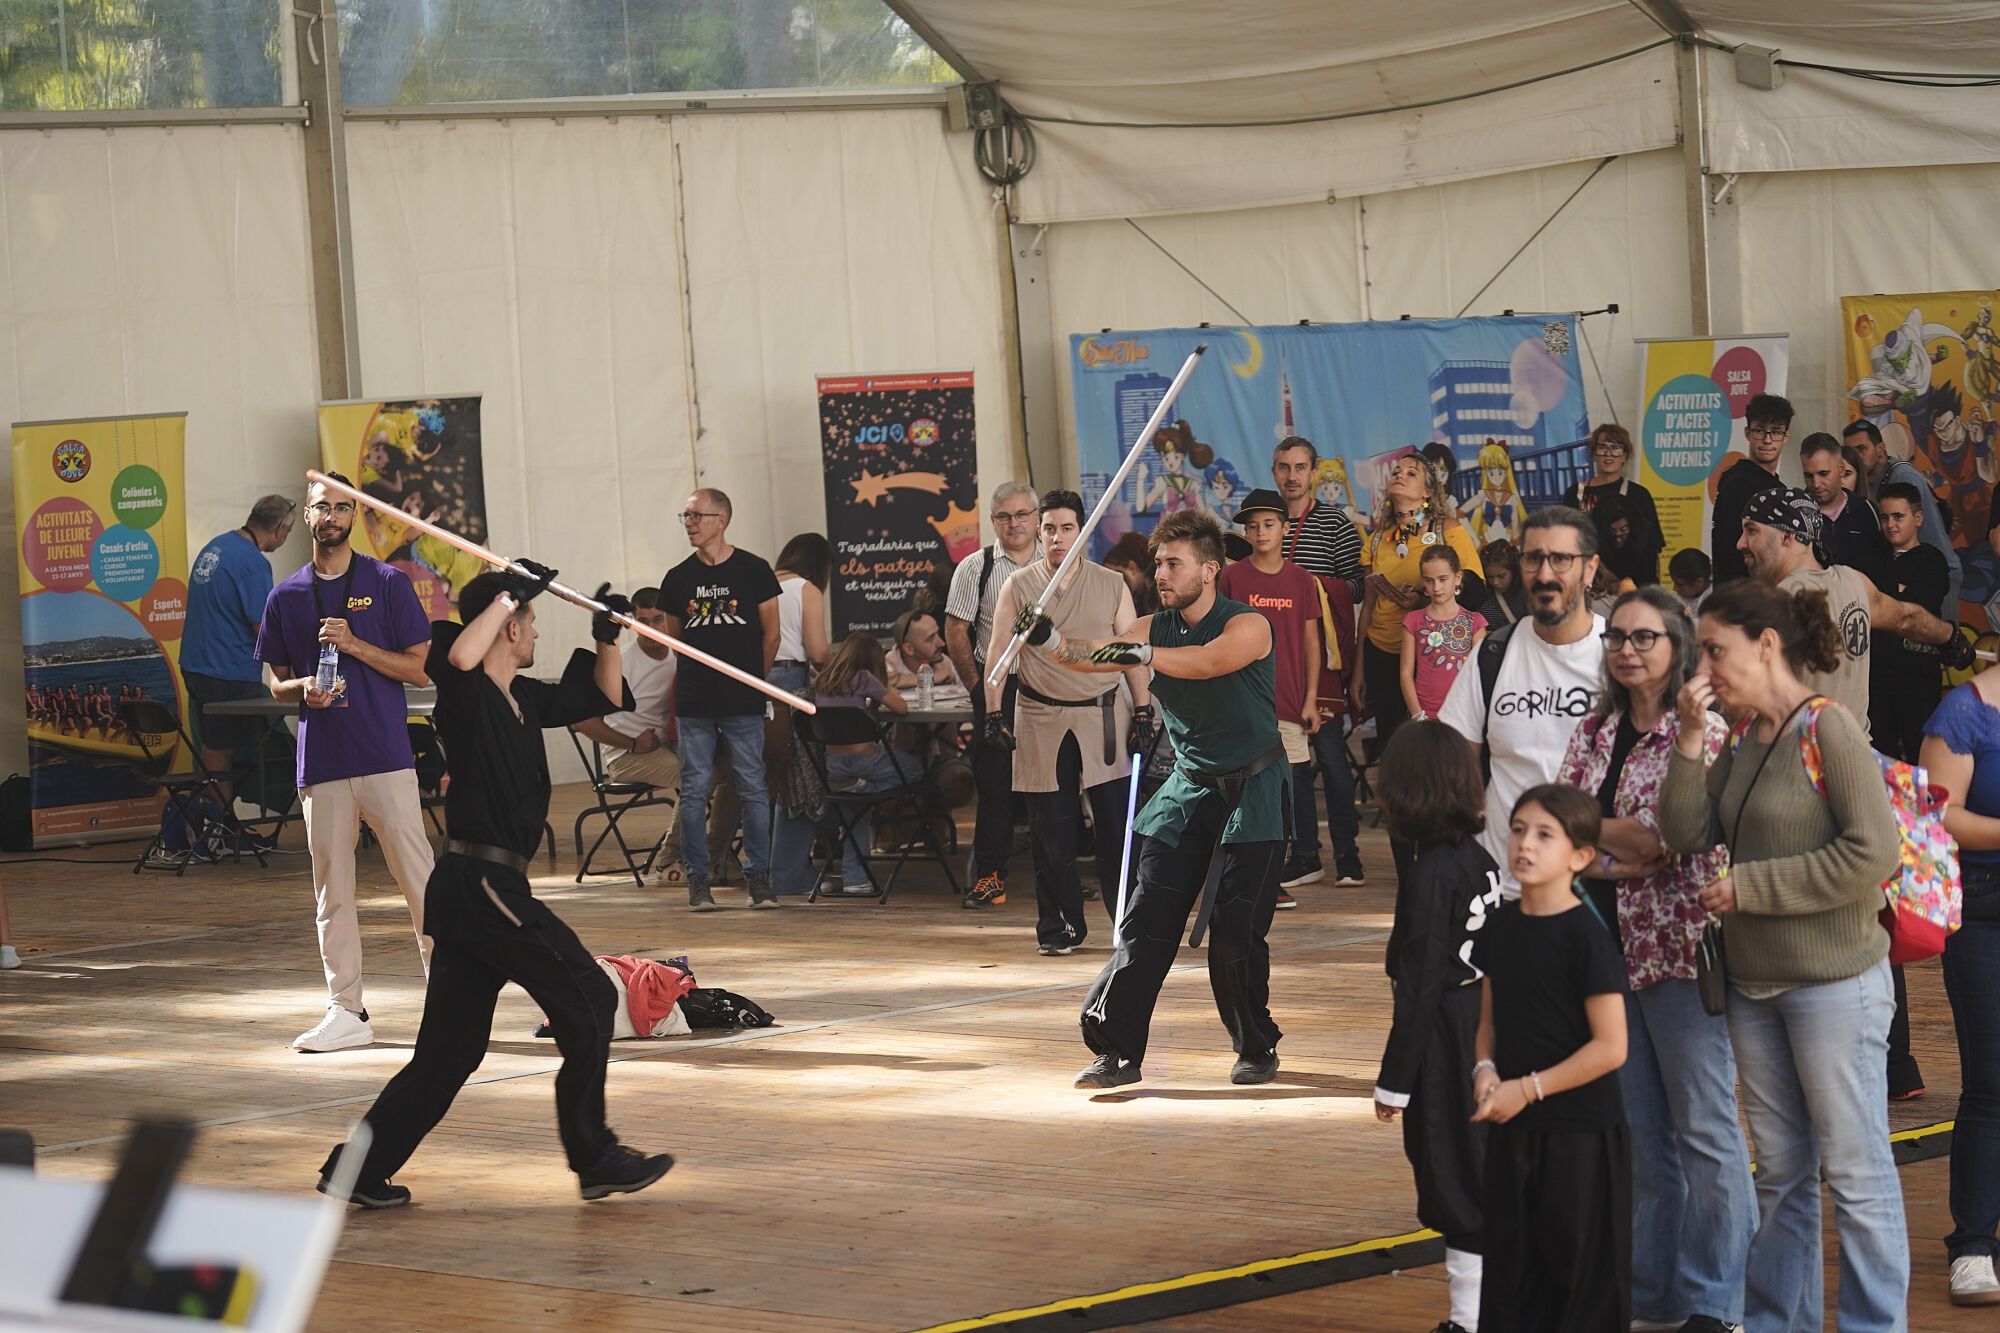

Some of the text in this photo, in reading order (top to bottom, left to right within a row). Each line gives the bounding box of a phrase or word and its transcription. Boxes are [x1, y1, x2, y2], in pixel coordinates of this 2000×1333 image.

[1727, 371, 1751, 382] SALSA
[1656, 393, 1721, 410] ACTIVITATS
[1665, 412, 1711, 429] D'ACTES
[854, 426, 888, 443] JCI
[1654, 431, 1712, 448] INFANTILS
[1659, 451, 1712, 467] JUVENILS
[117, 498, 163, 510] campaments
[36, 510, 93, 529] ACTIVITATS
[39, 527, 92, 544] DE LLEURE
[46, 543, 86, 561] JUVENIL
[99, 541, 148, 554] Casals d'estiu
[914, 540, 939, 553] que
[103, 555, 125, 563] CASALS
[839, 557, 935, 578] els patges
[864, 589, 907, 600] veure?
[1248, 594, 1293, 611] Kempa
[153, 598, 181, 610] Esports
